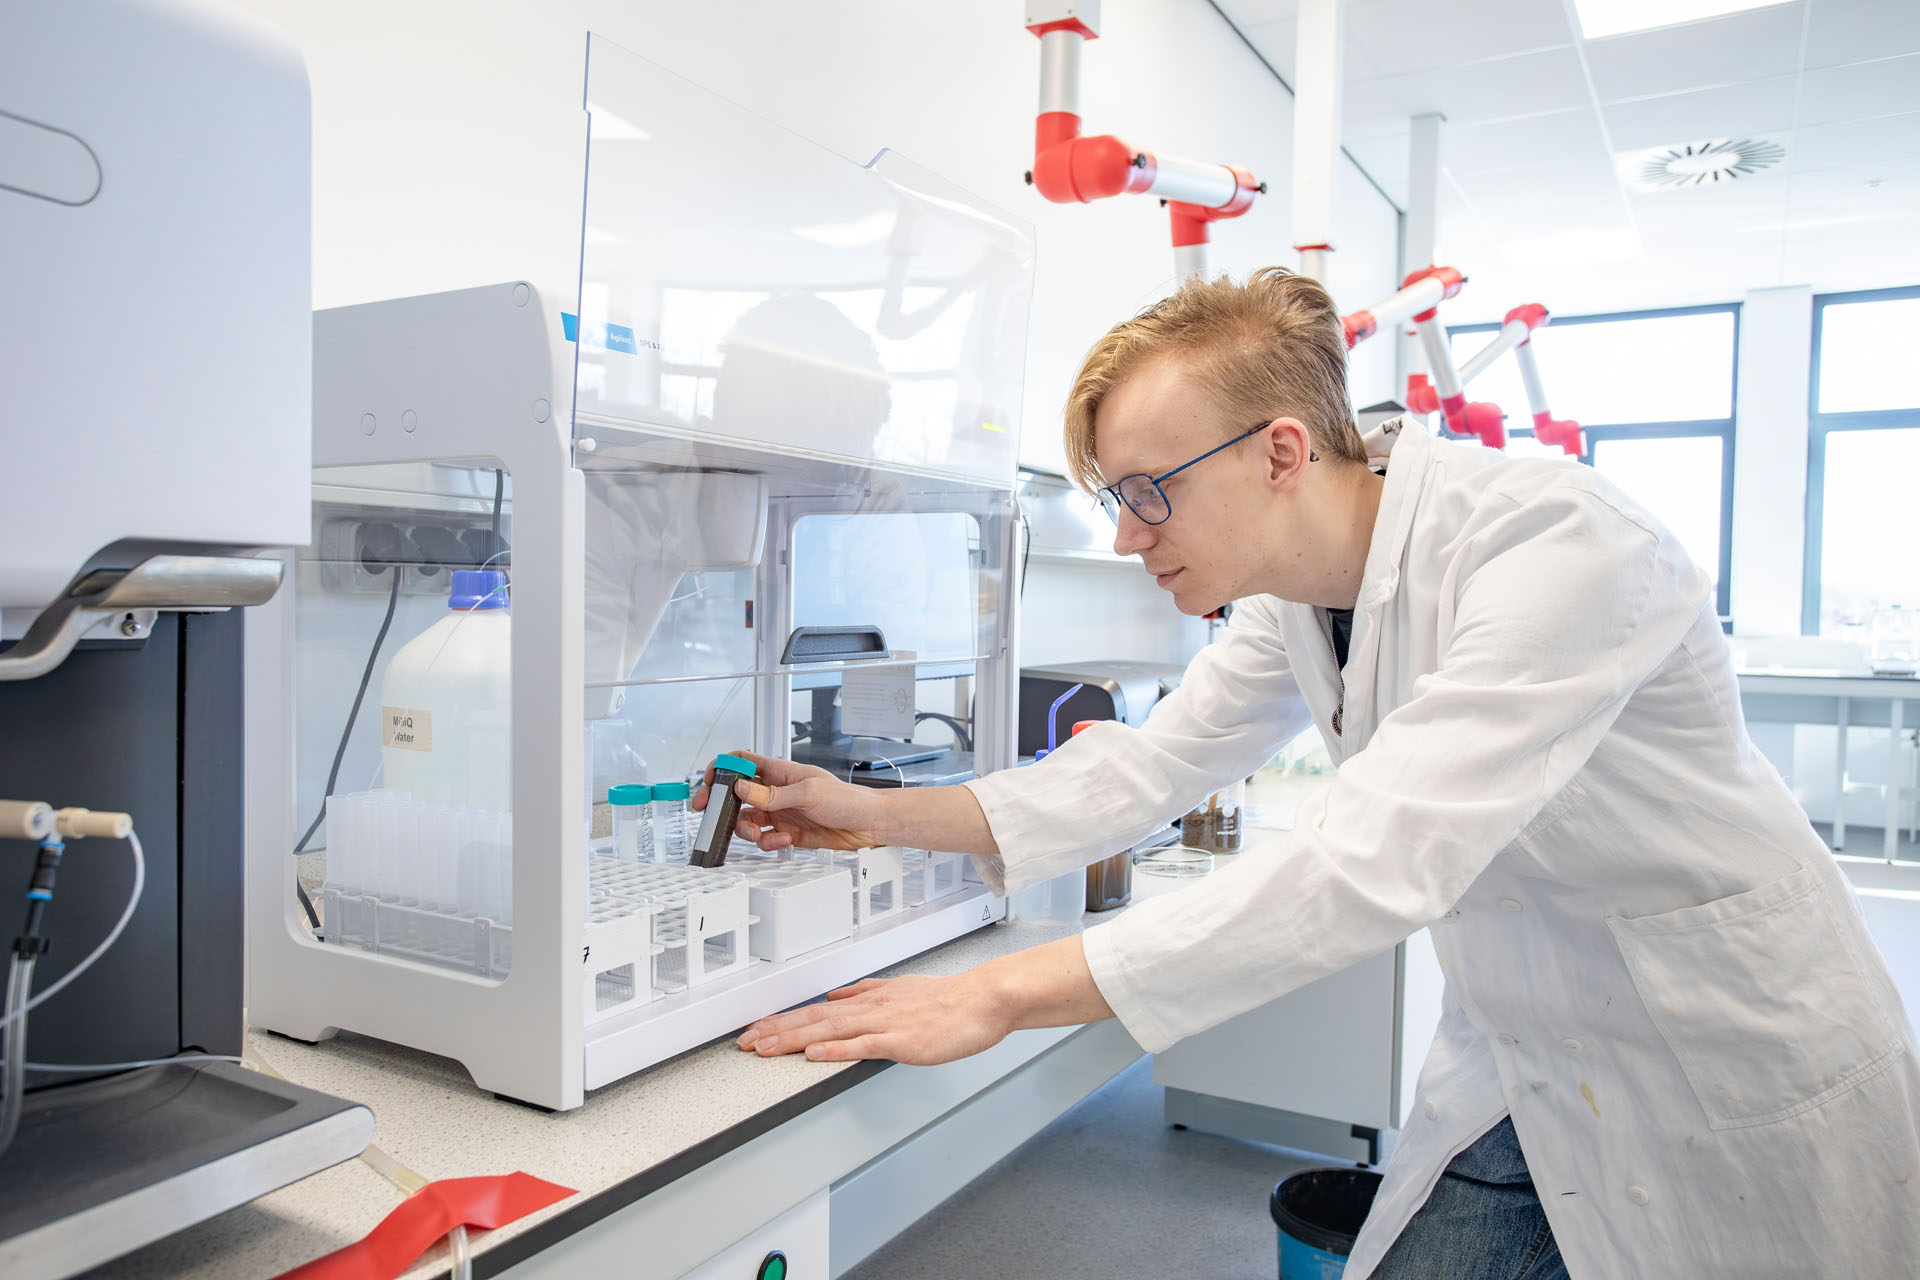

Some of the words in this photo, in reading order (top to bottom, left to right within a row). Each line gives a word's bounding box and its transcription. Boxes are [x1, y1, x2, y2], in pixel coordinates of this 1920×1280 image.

[610, 332, 632, 345] Agilent
[393, 731, 415, 743] Water
[862, 867, 868, 879] 4
[583, 945, 590, 965] 7
